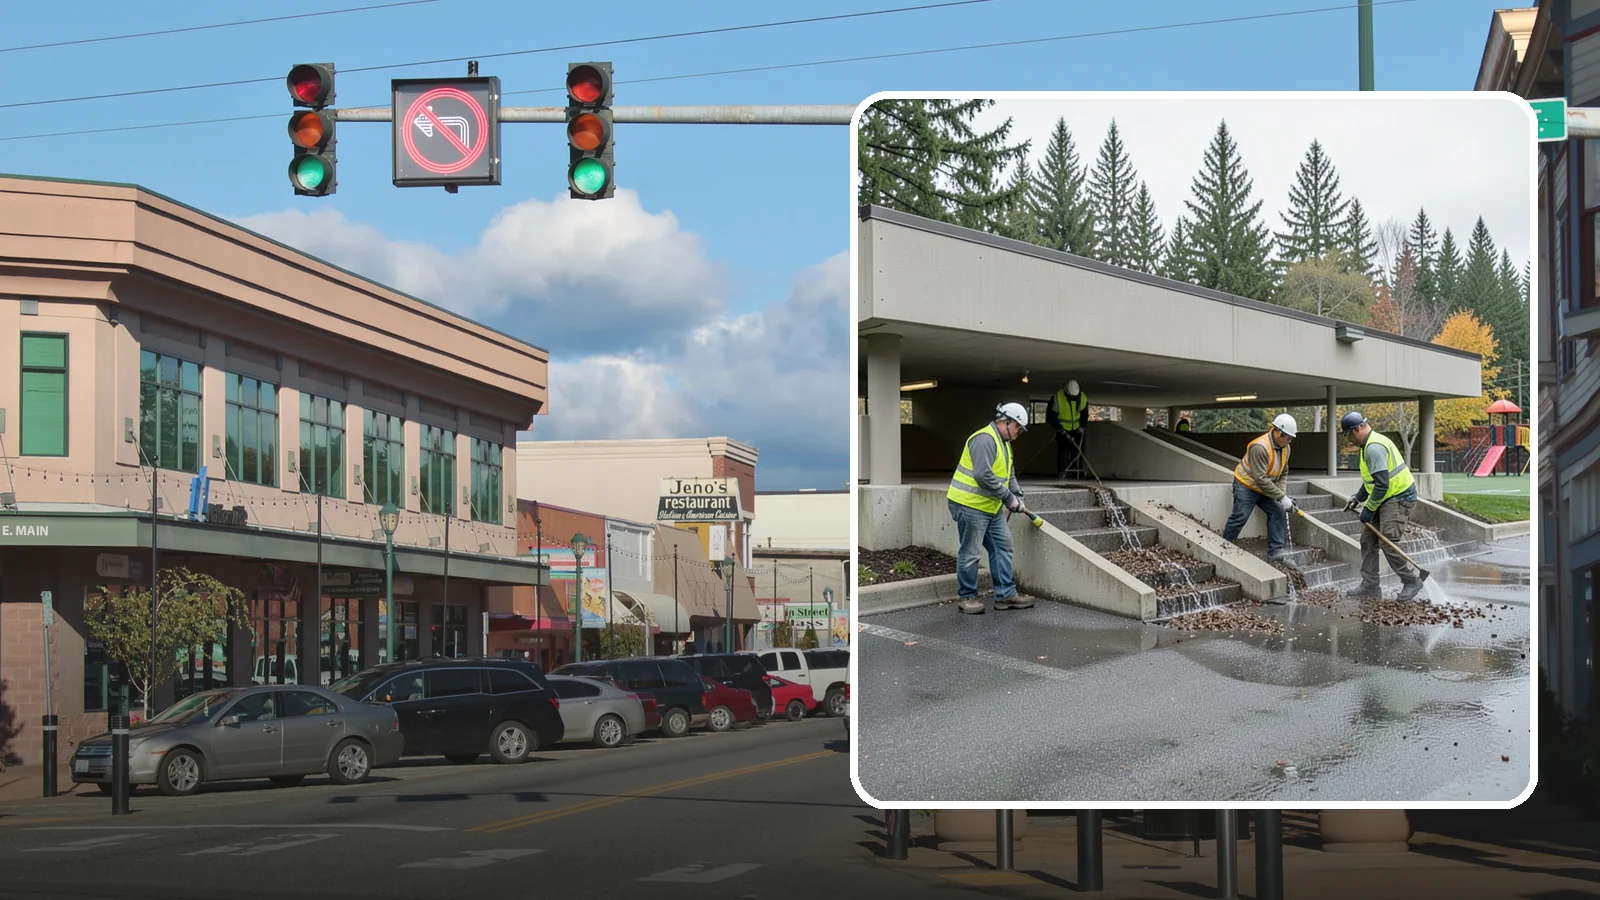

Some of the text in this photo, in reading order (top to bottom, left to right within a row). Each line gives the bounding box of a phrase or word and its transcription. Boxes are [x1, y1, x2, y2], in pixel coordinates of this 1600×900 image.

[669, 480, 727, 494] Jeno's
[665, 496, 731, 509] restaurant
[658, 509, 681, 519] Italian
[686, 510, 714, 519] American
[715, 509, 737, 519] Cuisine
[2, 525, 49, 536] E. MAIN
[797, 607, 829, 617] Street
[791, 619, 824, 627] lass
